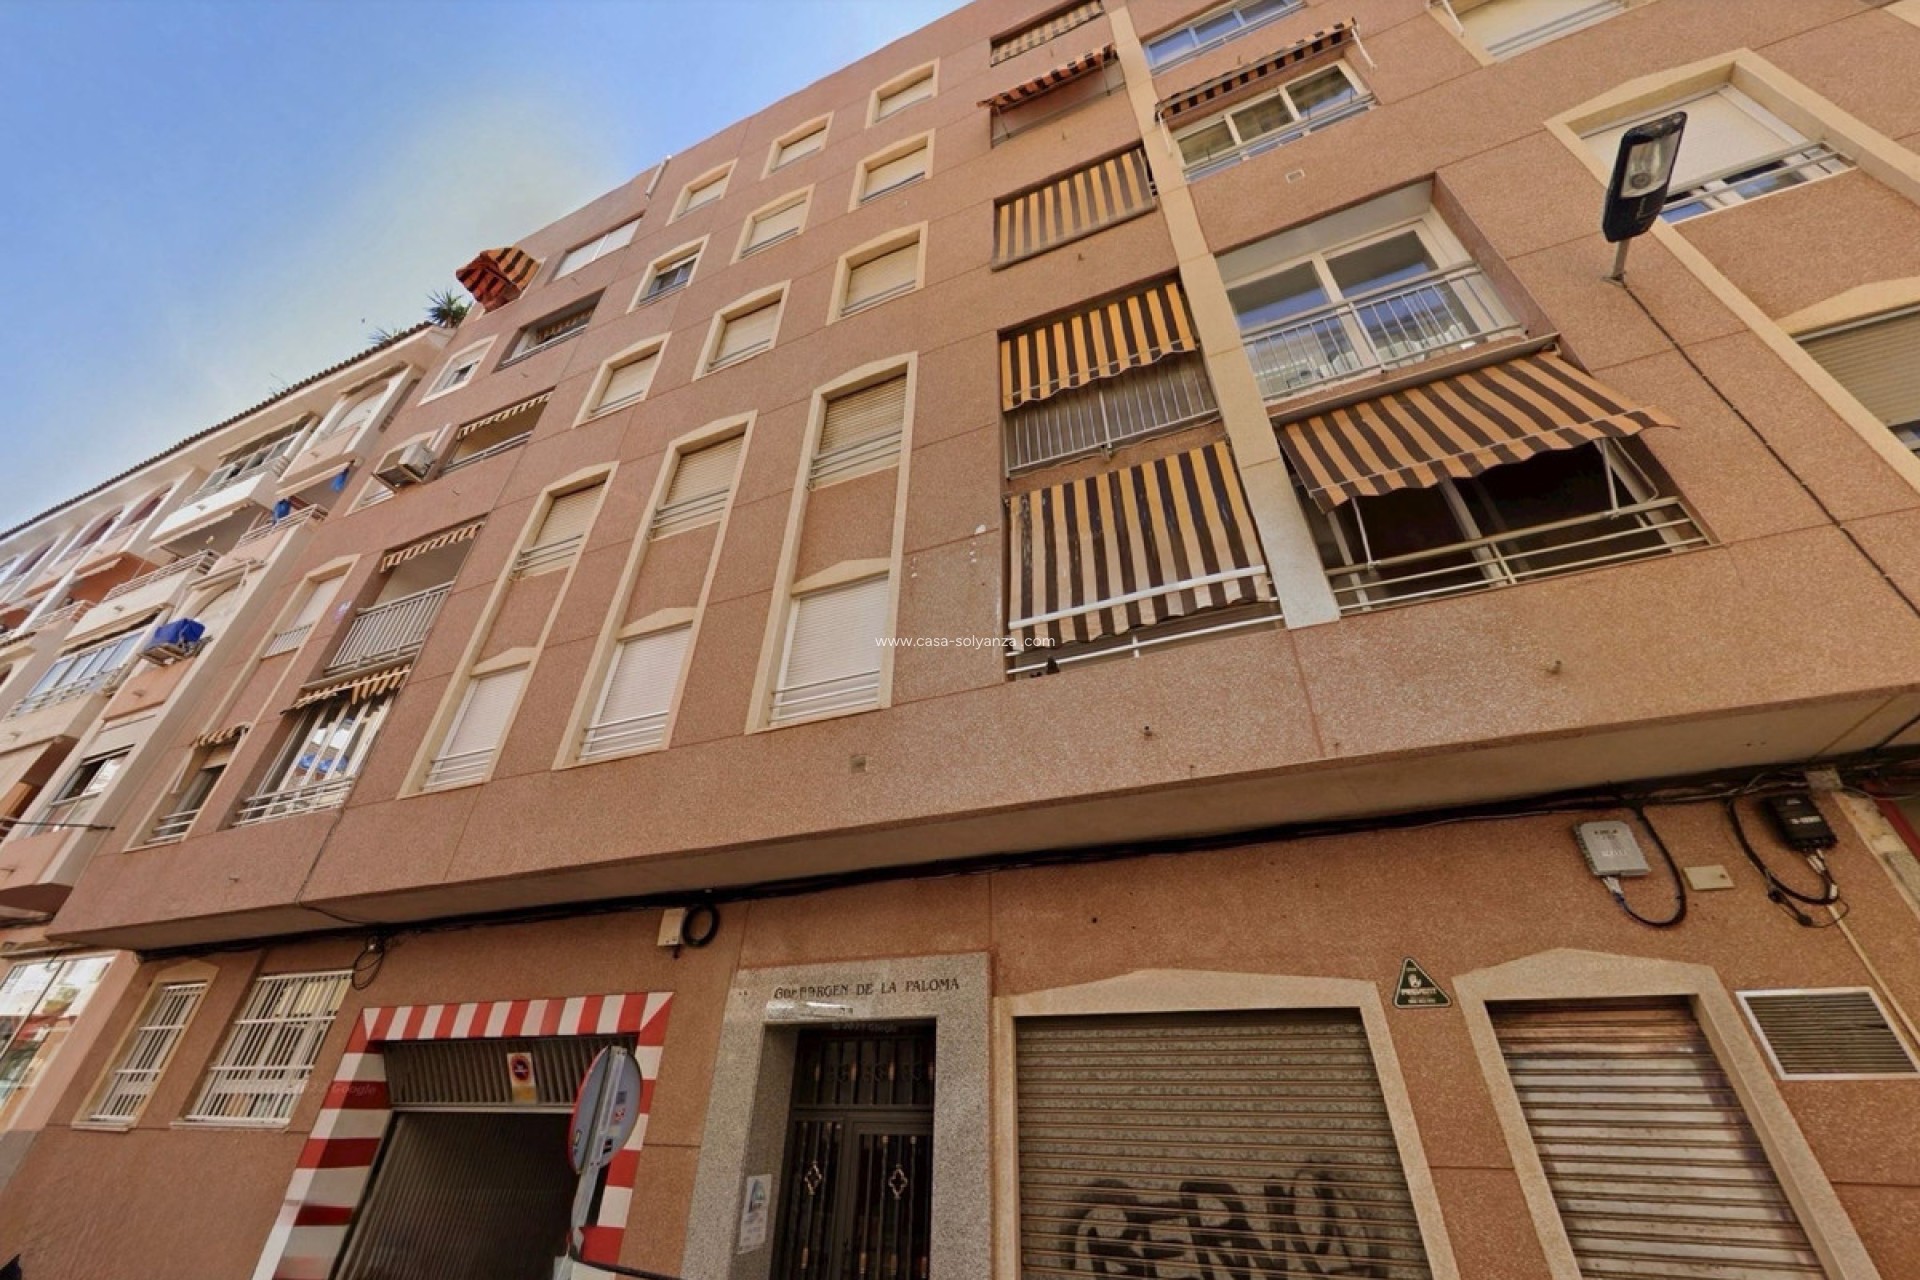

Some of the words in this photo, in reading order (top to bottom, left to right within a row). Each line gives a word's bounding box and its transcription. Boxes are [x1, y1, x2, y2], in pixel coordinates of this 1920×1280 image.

[855, 982, 873, 996] DE
[881, 981, 897, 994] LA
[905, 978, 961, 993] PALOMA
